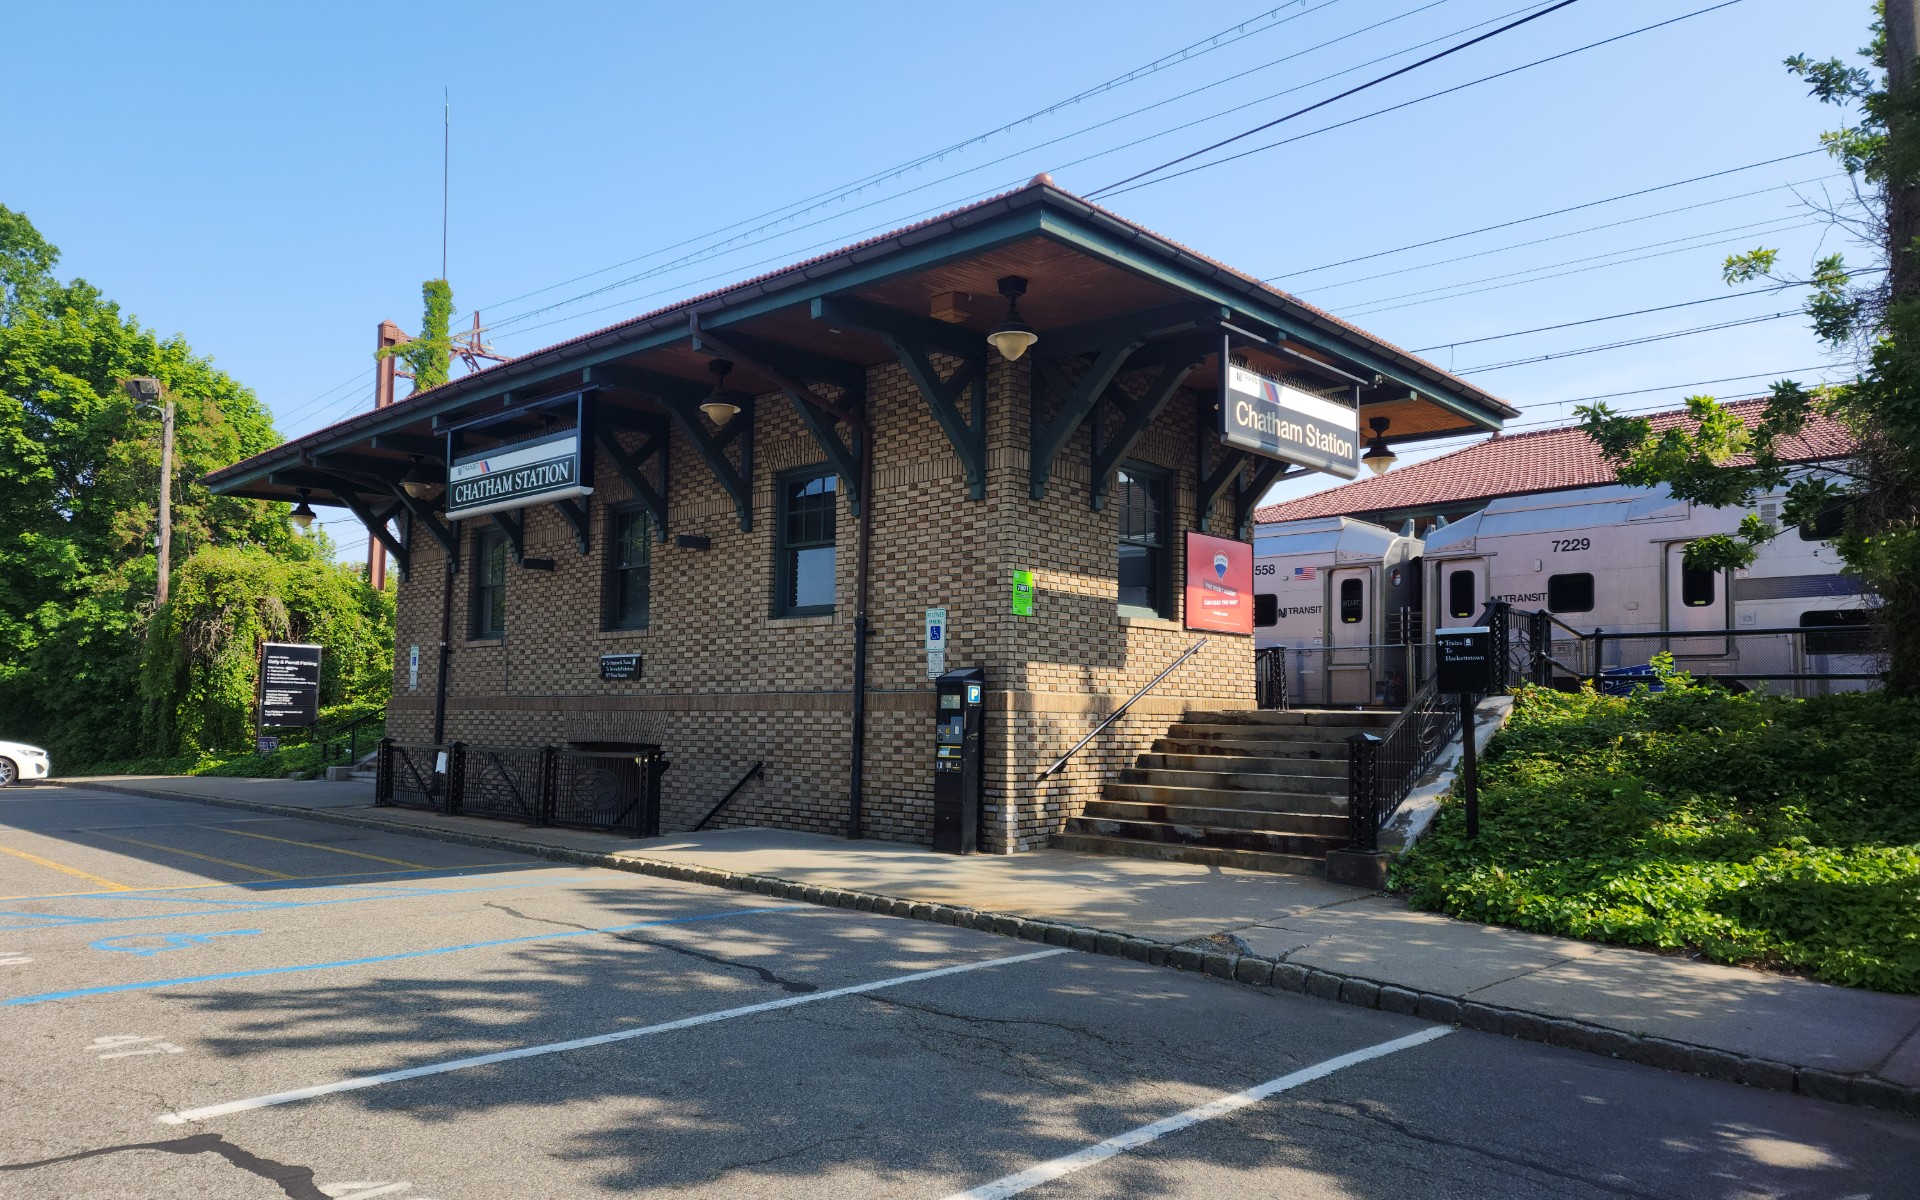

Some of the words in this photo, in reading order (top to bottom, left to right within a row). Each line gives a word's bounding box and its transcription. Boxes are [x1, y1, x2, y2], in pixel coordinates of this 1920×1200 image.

[1236, 401, 1302, 444] Chatham
[1306, 424, 1352, 460] Station
[462, 462, 479, 472] TRANSIT
[456, 475, 512, 503] CHATHAM
[515, 461, 570, 490] STATION
[1552, 538, 1590, 552] 7229
[1254, 564, 1276, 576] 558
[1504, 592, 1547, 603] TRANSIT
[1288, 606, 1322, 615] TRANSIT
[971, 688, 979, 700] P
